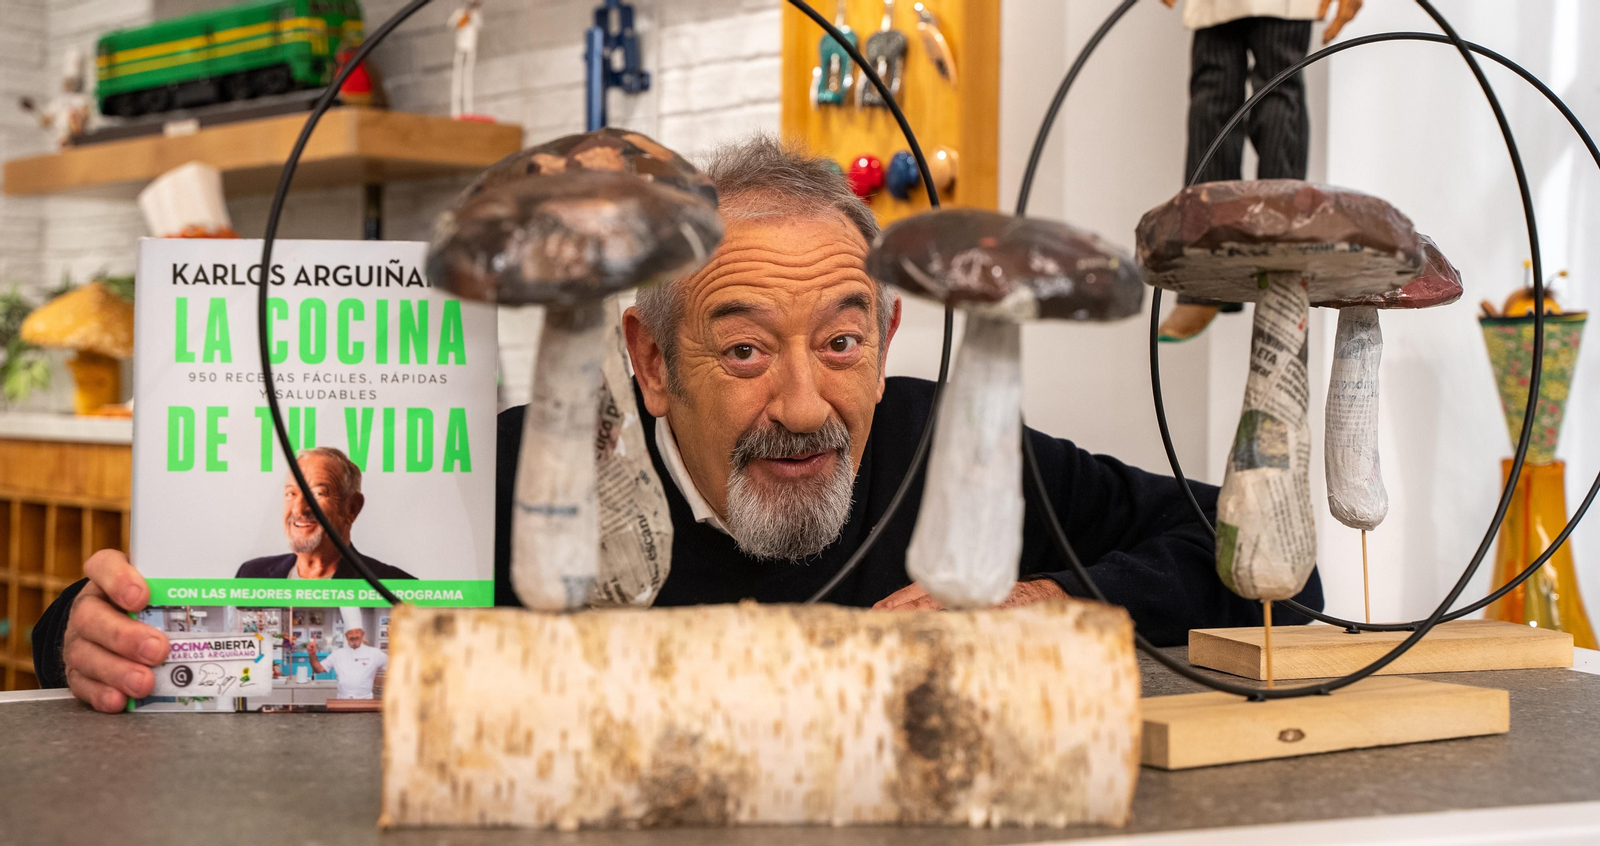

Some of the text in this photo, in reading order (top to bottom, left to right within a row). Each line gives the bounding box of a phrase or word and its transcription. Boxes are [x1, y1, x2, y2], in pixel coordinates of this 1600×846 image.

[172, 259, 433, 288] KARLOS ARGUIÑA
[174, 297, 467, 365] LA COCINA
[188, 371, 448, 384] 950 RECEAS FÁCILES, RÁPIDAS
[276, 389, 377, 400] SALUDABLES
[167, 406, 229, 472] DE
[344, 407, 472, 473] VIDA
[167, 588, 198, 599] CON
[201, 588, 226, 599] LAS
[230, 588, 292, 600] MEJORES
[295, 589, 355, 600] RECETAS
[358, 589, 383, 601] DEL
[171, 649, 256, 660] KARLOS ARGUIÑANO
